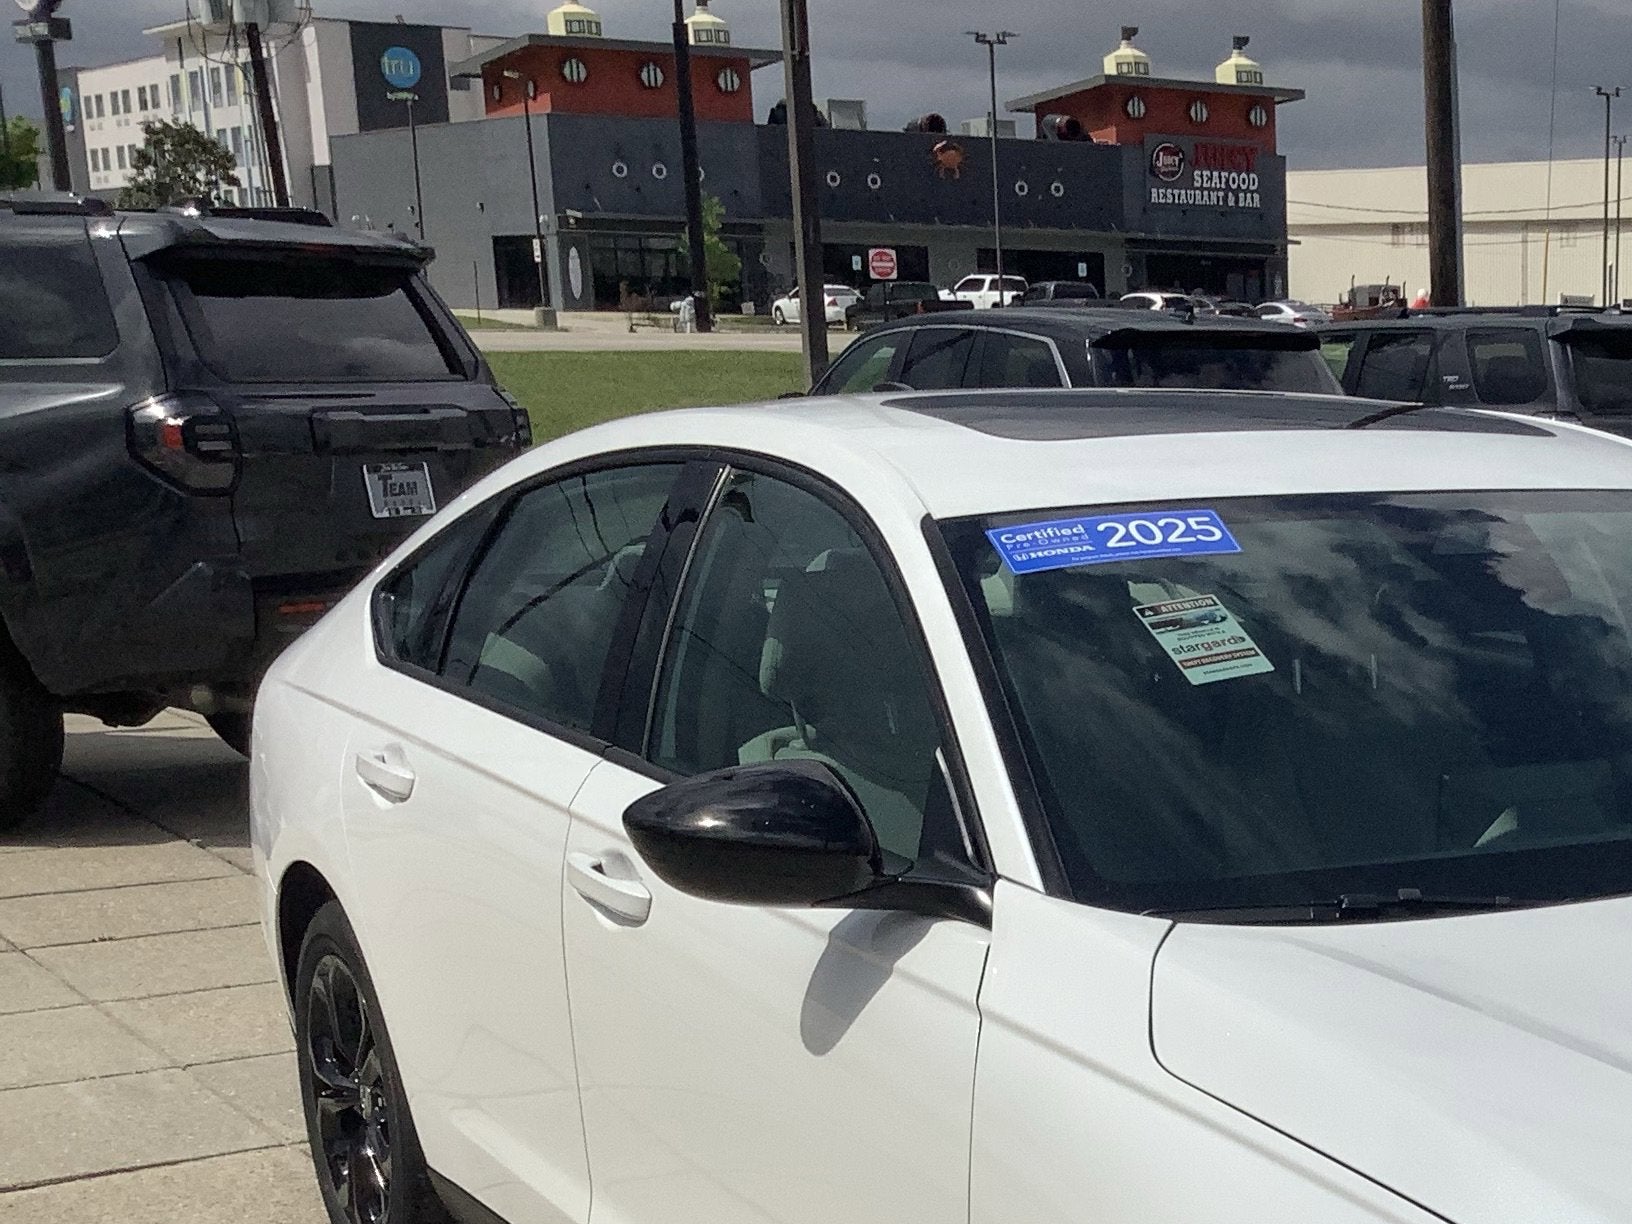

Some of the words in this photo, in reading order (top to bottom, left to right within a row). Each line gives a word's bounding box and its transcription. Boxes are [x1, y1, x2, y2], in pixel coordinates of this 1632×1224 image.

[1193, 170, 1259, 190] SEAFOOD
[1151, 188, 1224, 206] RESTAURANT
[1227, 192, 1236, 207] &
[1238, 192, 1261, 208] BAR
[378, 474, 418, 498] TEAM
[1000, 524, 1085, 545] Certified
[1005, 534, 1090, 550] Pre-Owned
[1096, 517, 1223, 548] 2025
[1027, 544, 1096, 560] HONDA
[1160, 598, 1215, 613] ATTENTION
[1172, 635, 1238, 655] stargard
